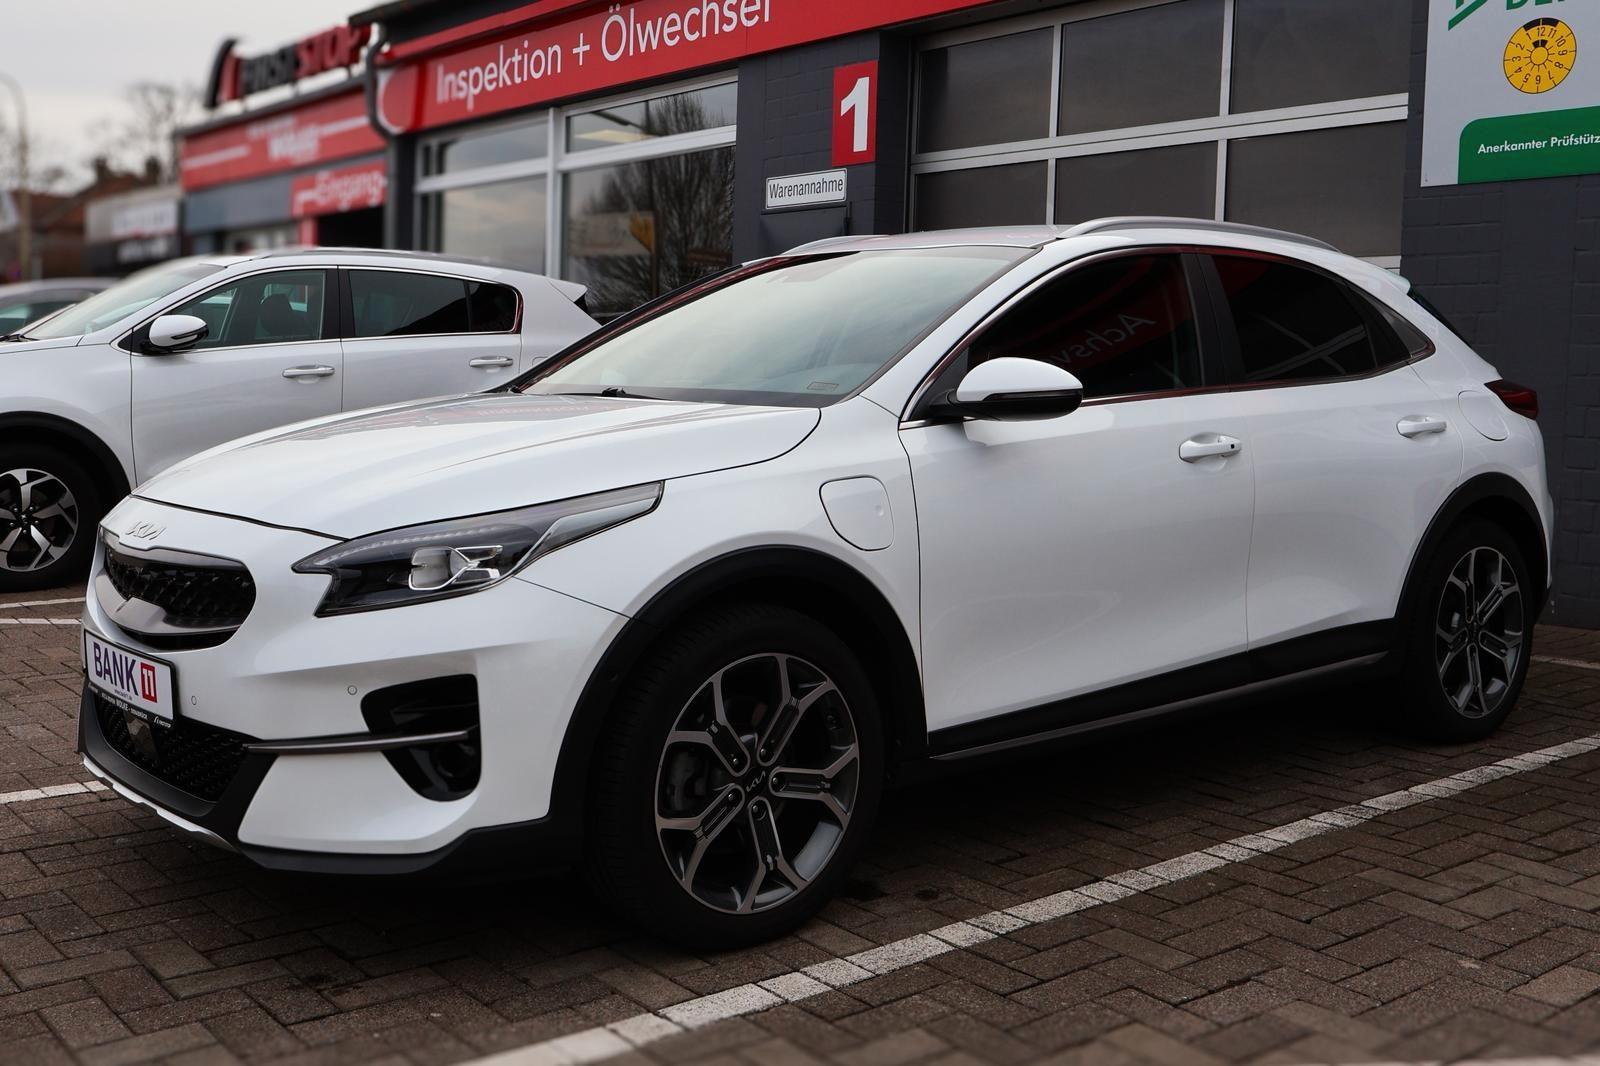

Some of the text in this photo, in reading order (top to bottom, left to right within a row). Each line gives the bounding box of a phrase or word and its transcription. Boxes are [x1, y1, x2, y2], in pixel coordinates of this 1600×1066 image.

[1536, 26, 1546, 37] 12
[1548, 28, 1557, 38] 11
[1555, 35, 1566, 47] 10
[1554, 61, 1564, 69] 8
[436, 40, 561, 111] Inspektion
[572, 32, 591, 66] +
[1523, 73, 1531, 83] 5
[1535, 75, 1541, 85] 6
[840, 76, 870, 152] 1
[1477, 134, 1600, 154] Anerkannter Prüfstütz
[769, 177, 844, 199] Warenannahme
[93, 641, 139, 697] BANK
